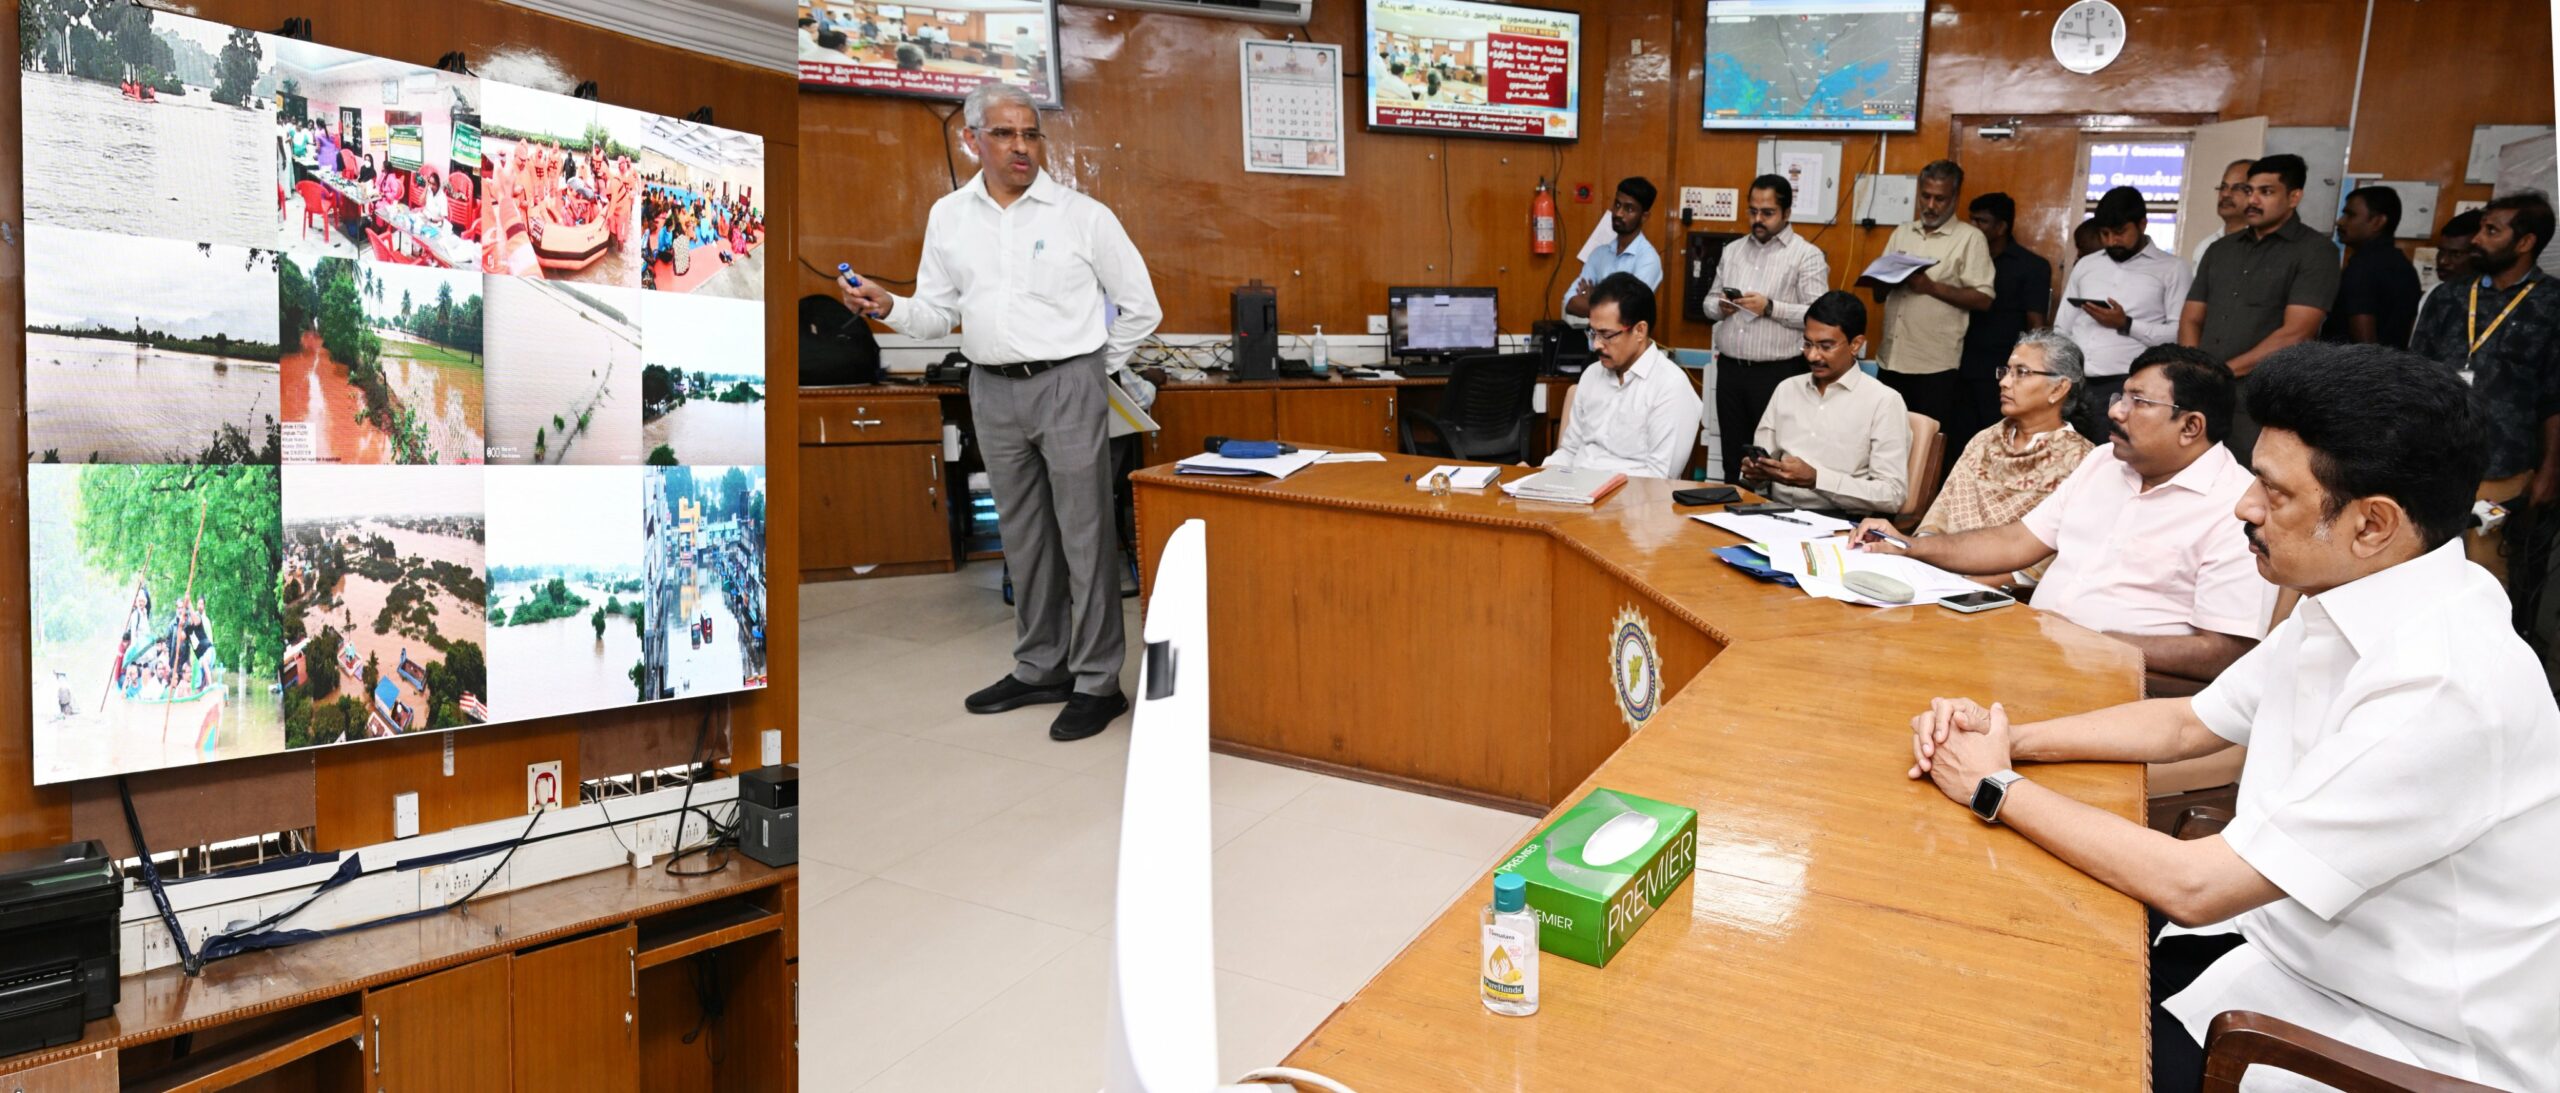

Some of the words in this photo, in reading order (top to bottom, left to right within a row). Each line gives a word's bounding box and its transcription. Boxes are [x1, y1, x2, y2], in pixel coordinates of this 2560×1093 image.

[1504, 843, 1540, 872] PREMIER
[1608, 831, 1693, 948] PREMIER
[1534, 909, 1574, 930] EMIER
